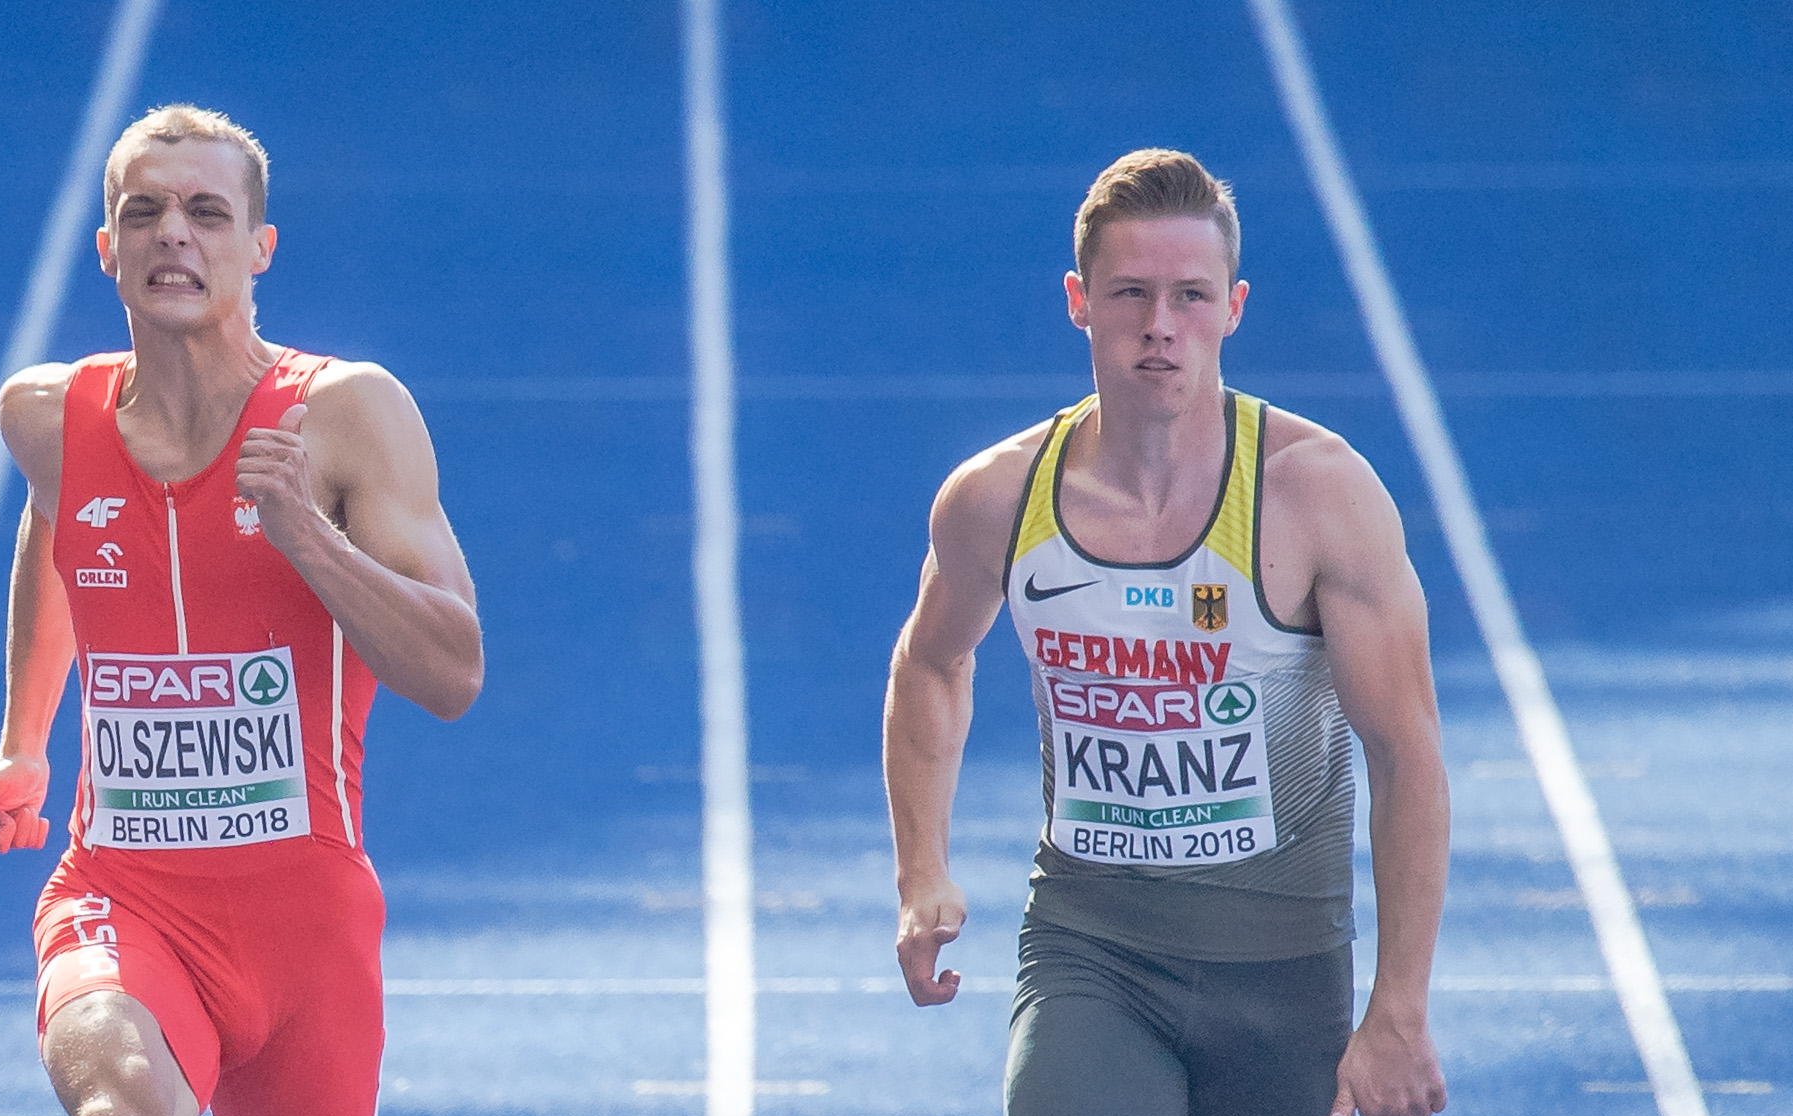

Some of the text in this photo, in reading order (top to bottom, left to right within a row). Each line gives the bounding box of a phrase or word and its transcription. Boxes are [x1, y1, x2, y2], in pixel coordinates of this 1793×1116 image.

[76, 497, 126, 528] 4F
[79, 572, 124, 585] ORLEN
[1126, 587, 1174, 607] DKB
[1035, 628, 1231, 684] GERMANY
[93, 665, 230, 702] SPAR
[1054, 684, 1196, 726] SPAR
[96, 713, 294, 779] OLSZEWSKI
[1064, 732, 1257, 798] KRANZ
[132, 792, 137, 807] I
[142, 791, 181, 807] RUN
[1101, 806, 1106, 821] I
[1111, 806, 1144, 825] RUN
[112, 807, 289, 843] BERLIN 2018
[1073, 827, 1255, 860] BERLIN 2018
[72, 893, 120, 979] OLSKA
